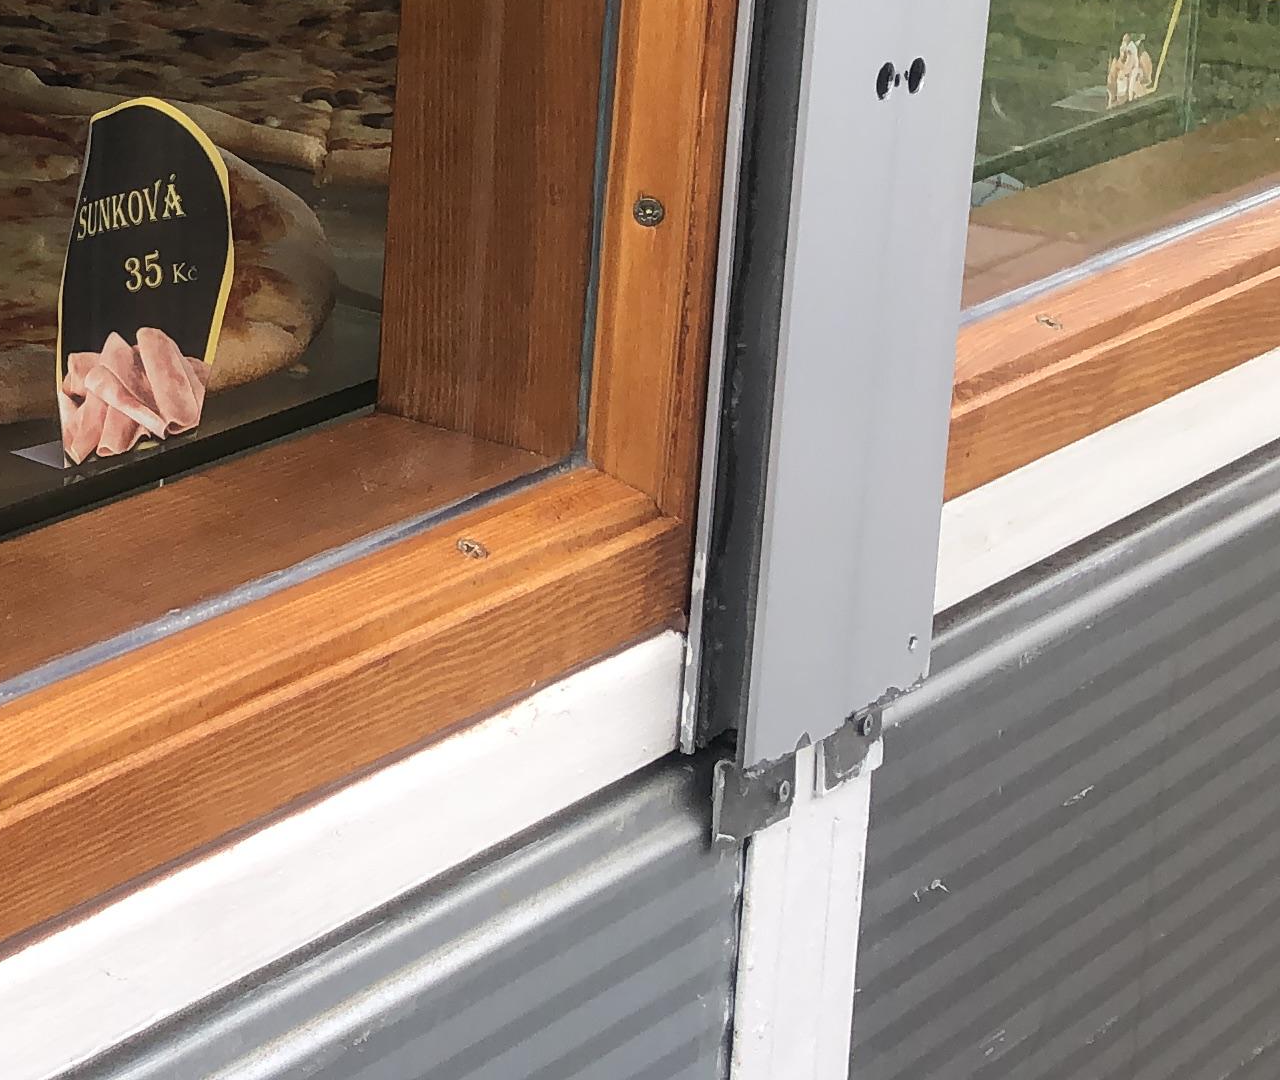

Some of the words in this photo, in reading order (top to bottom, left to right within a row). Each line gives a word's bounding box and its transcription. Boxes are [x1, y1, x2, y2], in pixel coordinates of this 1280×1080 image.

[77, 174, 186, 241] ŠUNKOVÁ
[125, 250, 163, 293] 35
[172, 263, 198, 284] Kč
